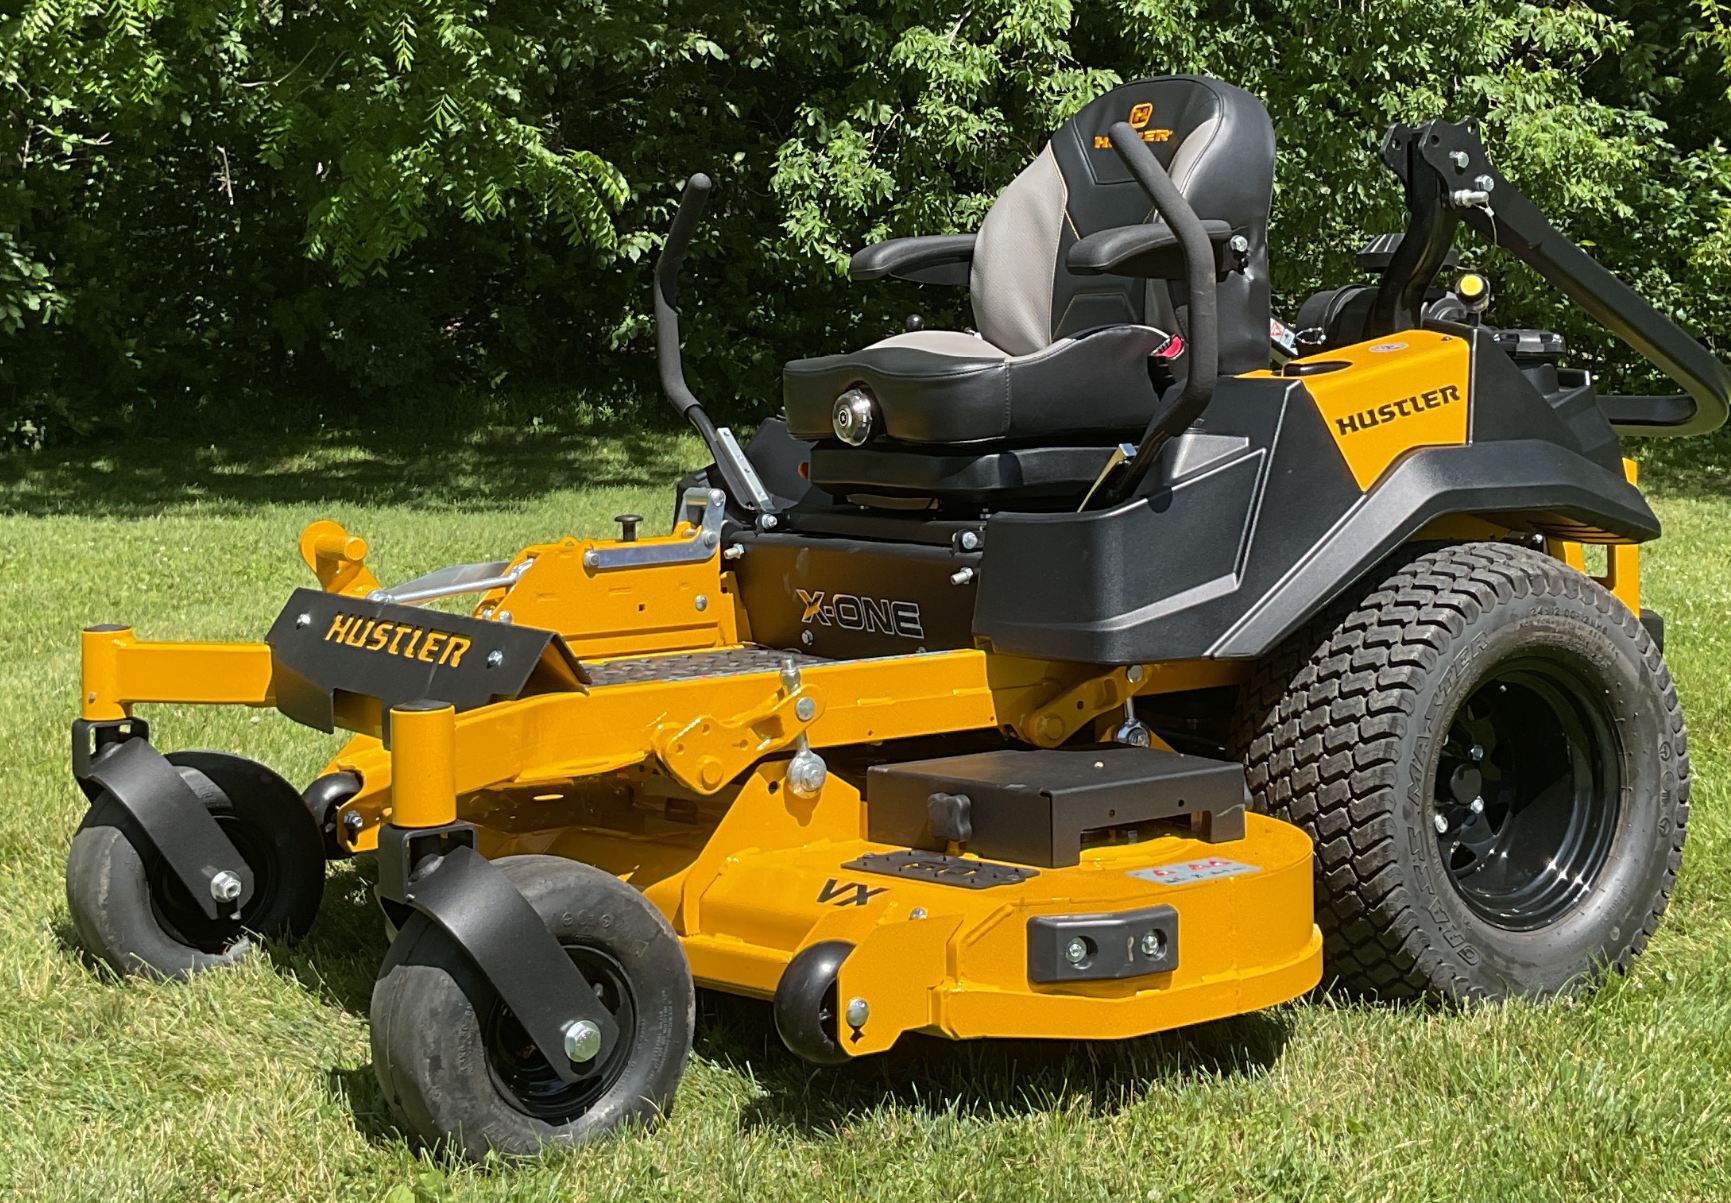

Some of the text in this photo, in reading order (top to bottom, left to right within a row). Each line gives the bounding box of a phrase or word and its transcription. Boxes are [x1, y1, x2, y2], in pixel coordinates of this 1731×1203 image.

[1335, 385, 1461, 436] HUSTLER
[796, 588, 925, 639] X-ONE
[324, 611, 472, 668] HUSTLER
[816, 878, 890, 906] VX
